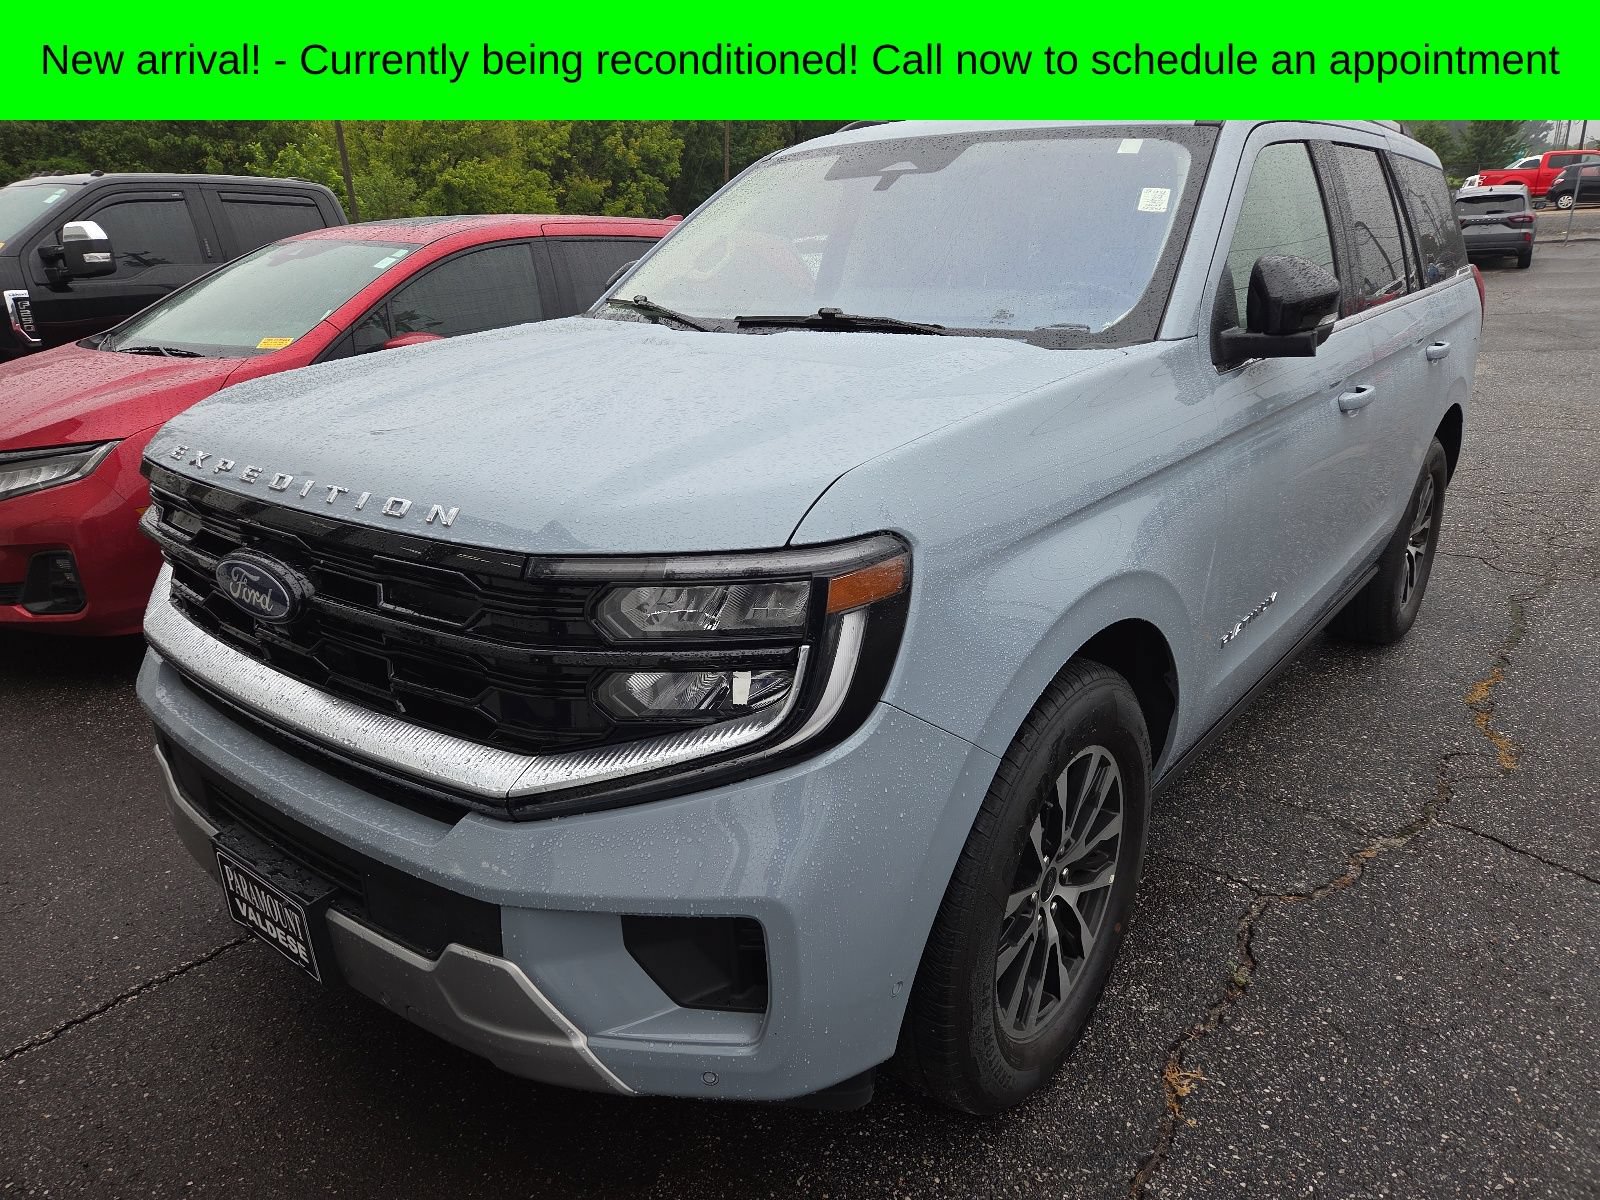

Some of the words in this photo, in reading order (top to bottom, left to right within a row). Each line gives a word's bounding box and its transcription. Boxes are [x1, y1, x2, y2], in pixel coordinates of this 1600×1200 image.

[168, 444, 462, 528] EXPEDITION
[229, 567, 273, 612] Ford
[223, 864, 304, 941] PARAMOUNT
[235, 897, 310, 963] VALDESE
